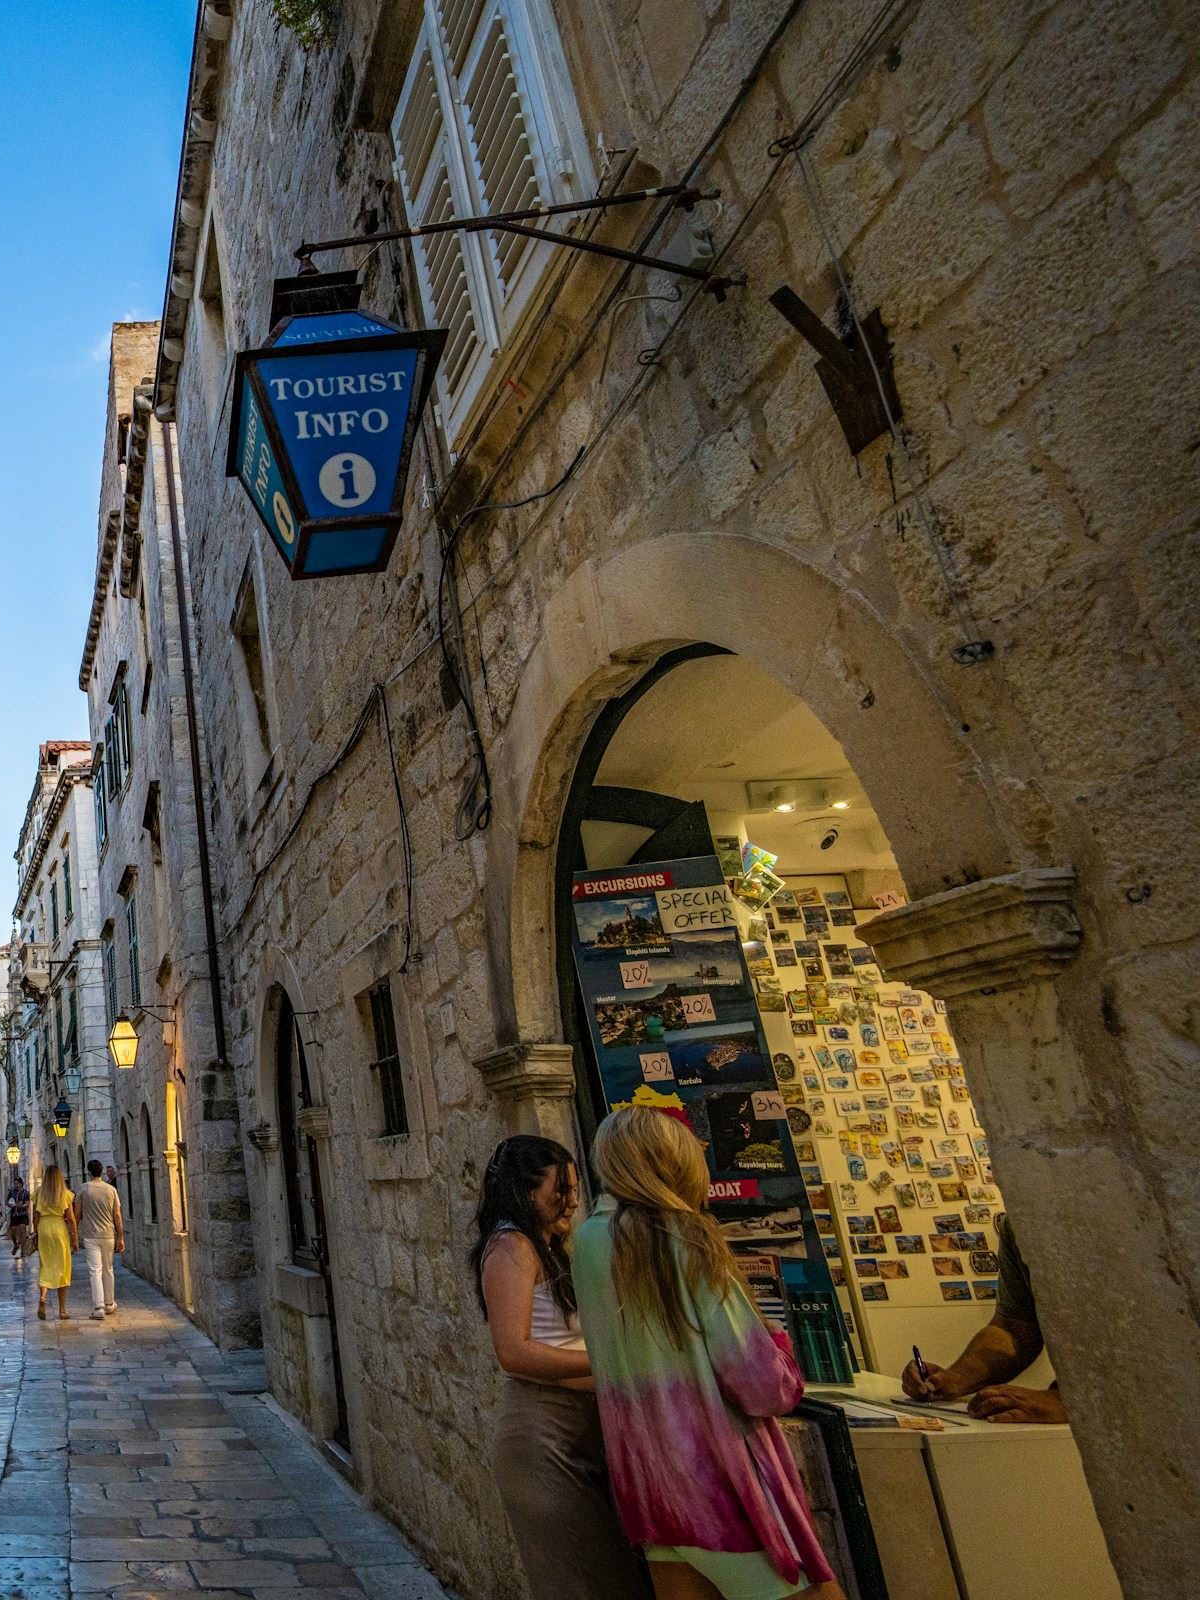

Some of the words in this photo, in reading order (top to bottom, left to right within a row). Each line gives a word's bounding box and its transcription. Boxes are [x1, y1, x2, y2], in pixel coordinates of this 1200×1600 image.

[270, 371, 405, 400] TOURIST
[295, 408, 389, 440] INFO
[584, 874, 666, 895] EXCURSIONS
[661, 890, 733, 910] SPECIAL
[674, 907, 736, 928] OFFER
[622, 964, 651, 984] 20%
[684, 998, 712, 1015] 20%
[643, 1058, 672, 1076] 20%
[755, 1097, 781, 1112] 3h
[708, 1182, 741, 1198] BOAT
